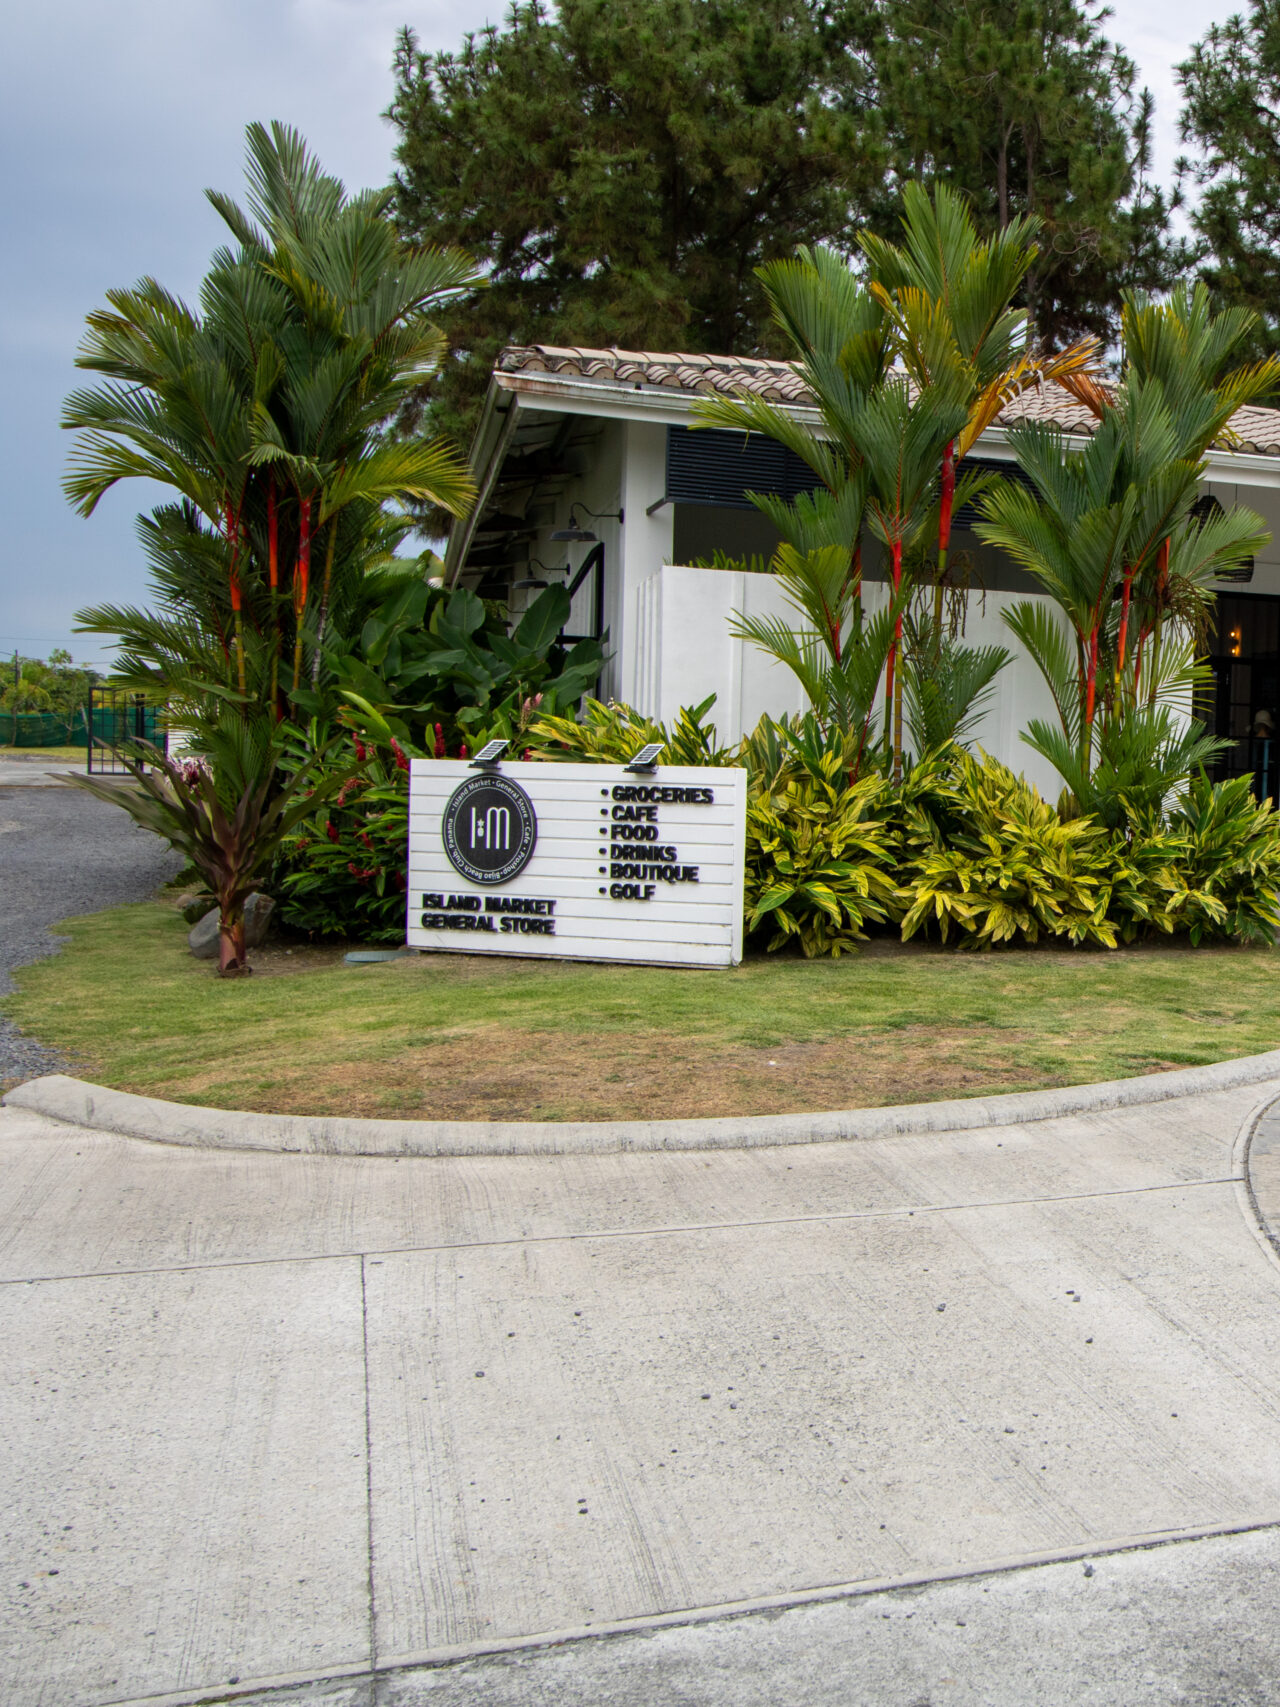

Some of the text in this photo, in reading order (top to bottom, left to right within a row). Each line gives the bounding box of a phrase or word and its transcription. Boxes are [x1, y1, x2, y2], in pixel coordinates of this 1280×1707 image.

[452, 779, 491, 807] Island Market
[495, 780, 528, 818] General Store
[611, 785, 714, 804] GROCERIES
[611, 805, 658, 822] CAFE
[447, 818, 455, 849] Panama
[610, 824, 659, 841] FOOD
[503, 850, 525, 874] Proshop
[610, 844, 678, 862] DRINKS
[464, 867, 483, 879] Beach
[610, 863, 700, 884] BOUTIQUE
[609, 883, 657, 901] GOLF
[422, 893, 557, 915] ISLAND MARKET
[421, 912, 556, 935] GENERAL STORE
